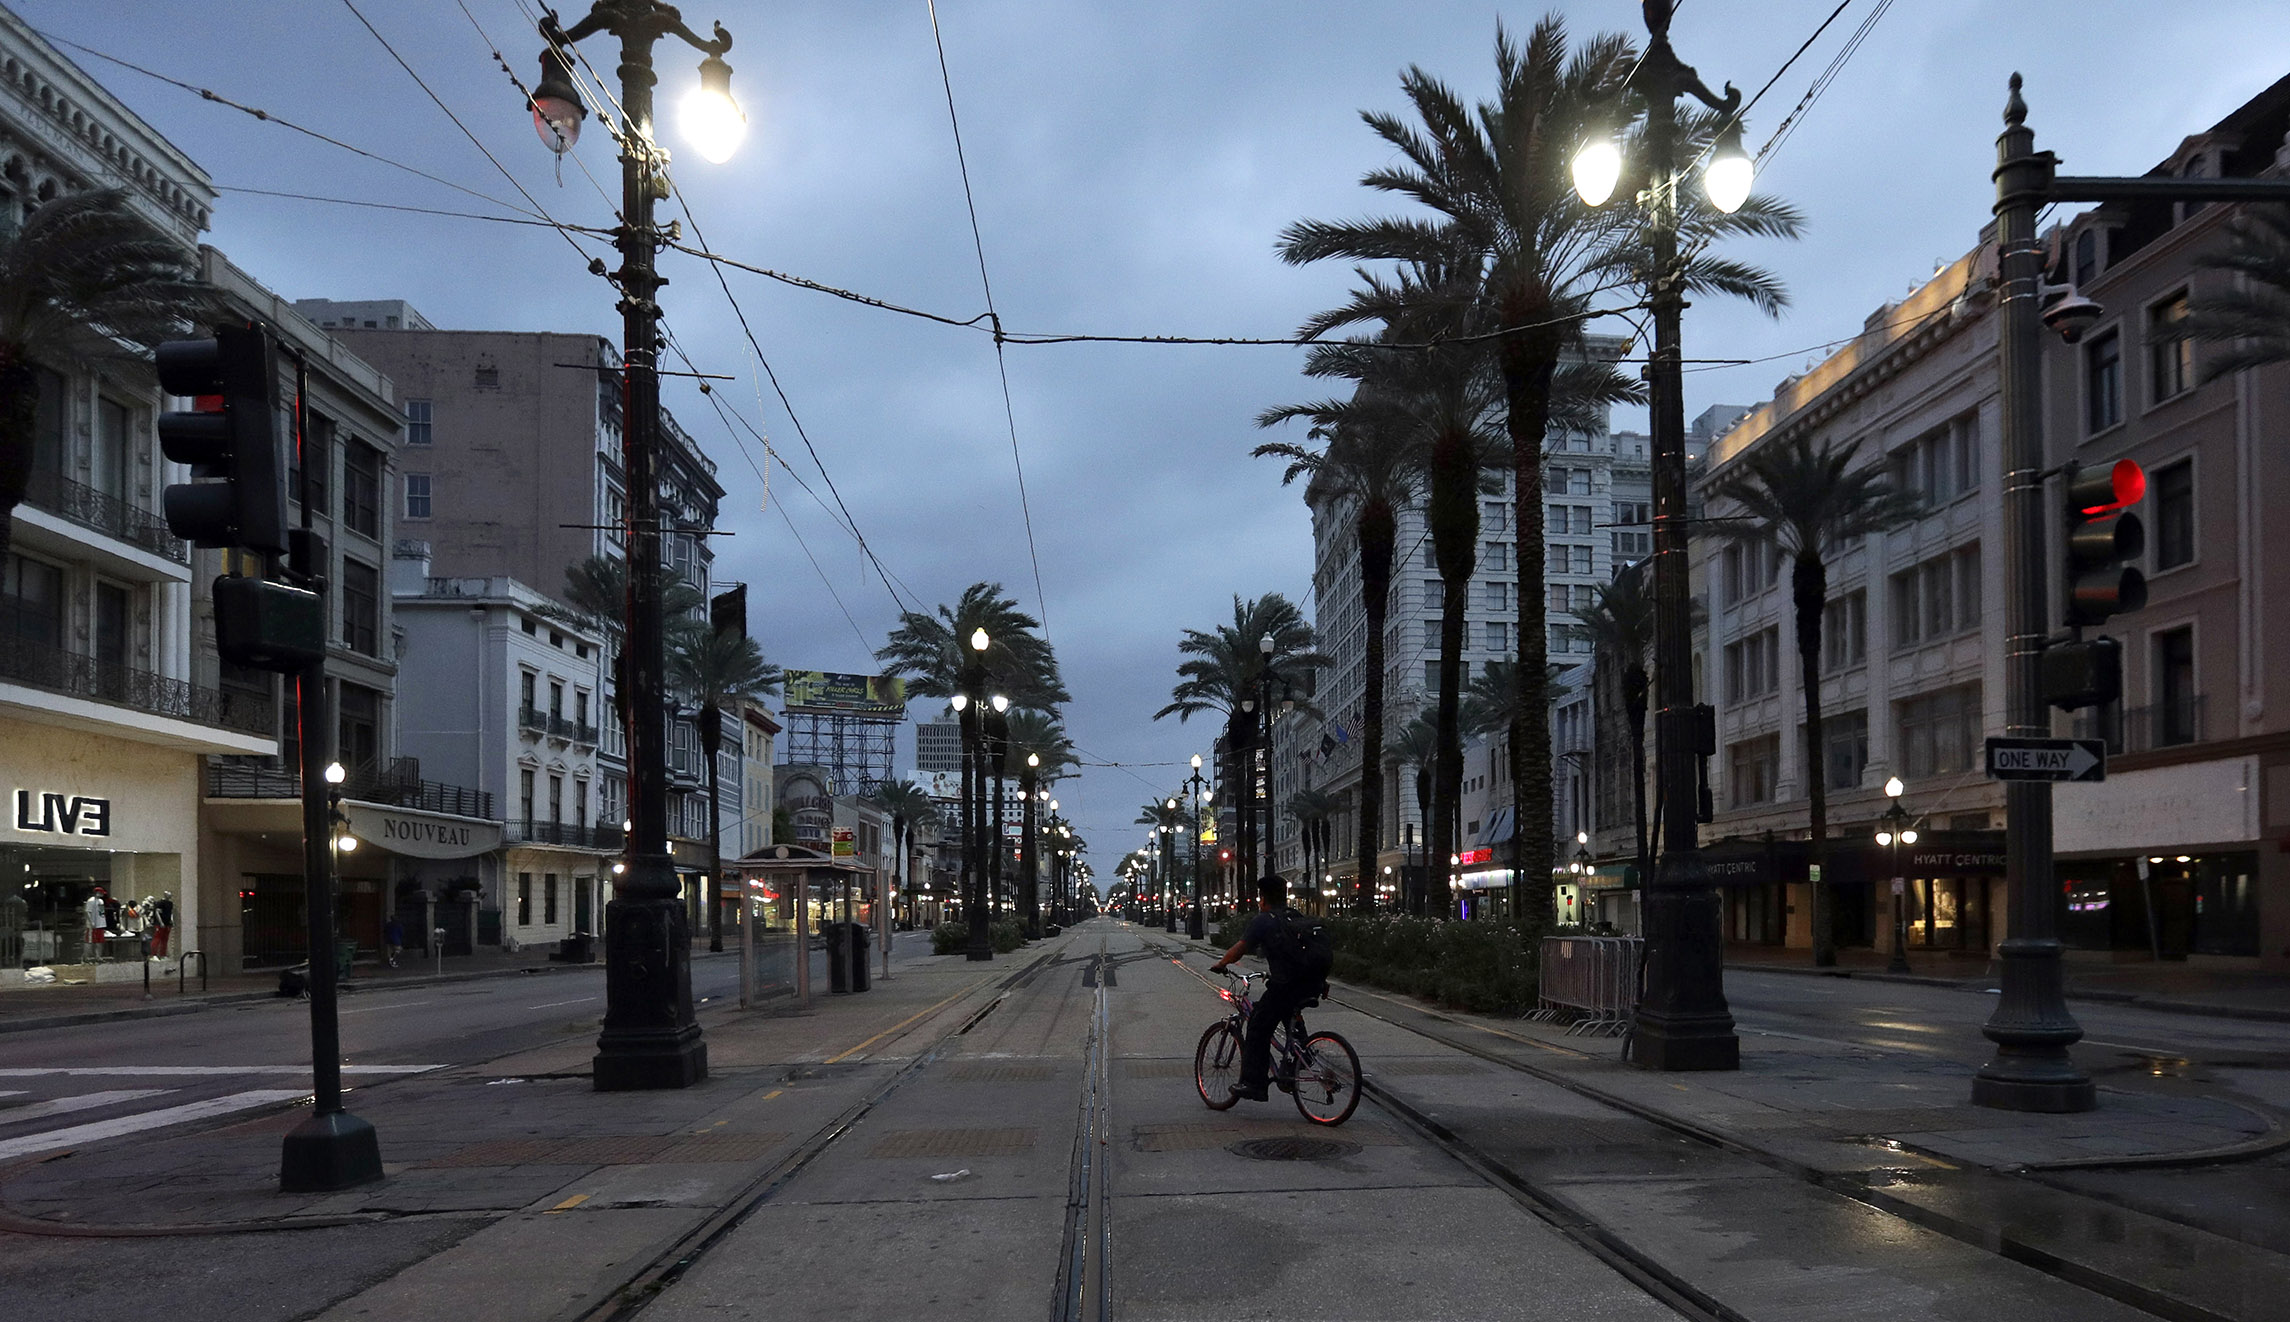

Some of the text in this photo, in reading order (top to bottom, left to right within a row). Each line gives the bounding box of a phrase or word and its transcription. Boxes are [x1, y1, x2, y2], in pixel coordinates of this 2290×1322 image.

[1999, 751, 2070, 769] ONE WAY
[384, 818, 470, 846] NOUVEAU
[1914, 854, 1953, 865] HYATT
